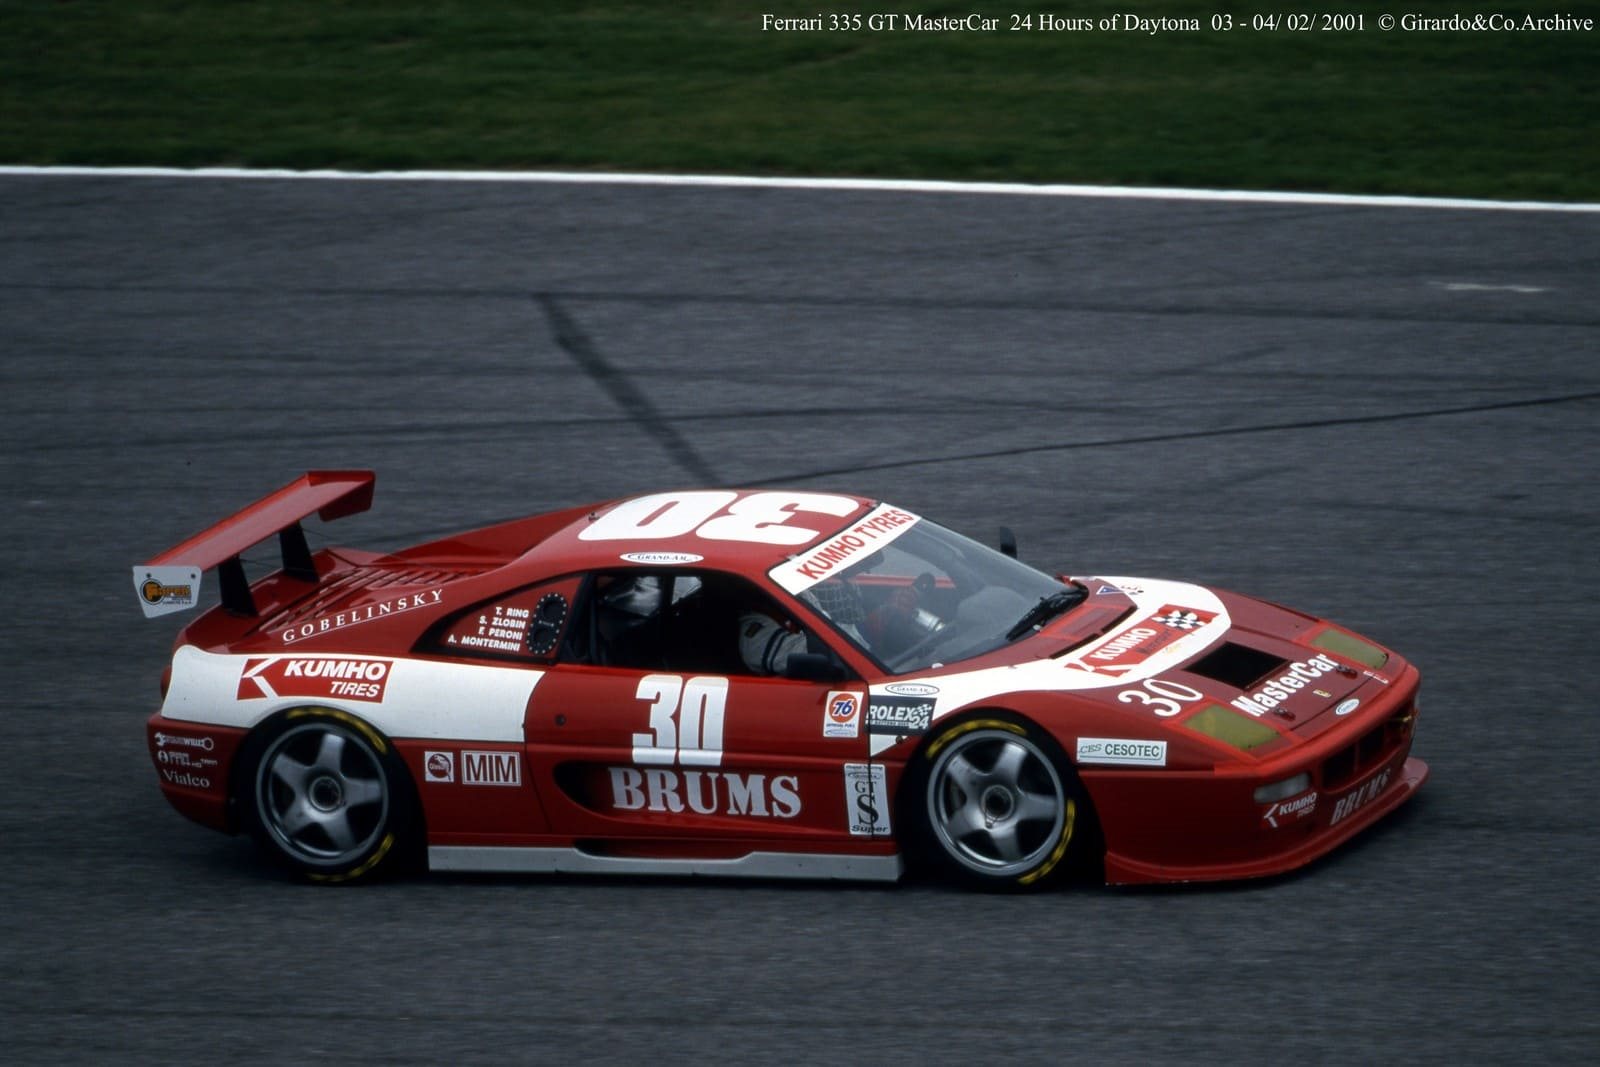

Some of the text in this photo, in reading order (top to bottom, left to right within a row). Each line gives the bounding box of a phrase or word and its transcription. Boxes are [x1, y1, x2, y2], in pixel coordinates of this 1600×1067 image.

[796, 509, 914, 580] KUMHO TYRES
[282, 589, 443, 643] GOBELINSKY
[491, 617, 527, 630] ZLOBIN
[506, 607, 530, 619] RING
[461, 635, 521, 652] MONTERMINI
[488, 627, 523, 641] PERONI
[1089, 627, 1157, 661] KUMHO
[284, 660, 387, 681] KUMHO
[329, 681, 381, 698] TIRES
[1230, 653, 1339, 717] MasterCar
[831, 698, 856, 717] 76
[1117, 678, 1204, 717] 30
[632, 673, 729, 767] 30
[865, 705, 917, 721] ROLEX
[908, 715, 930, 730] 24
[1104, 743, 1160, 757] CESOTEC
[162, 768, 210, 788] Vialco
[465, 753, 517, 783] MIM
[607, 766, 802, 818] BRUMS
[1279, 792, 1317, 816] KUMHO
